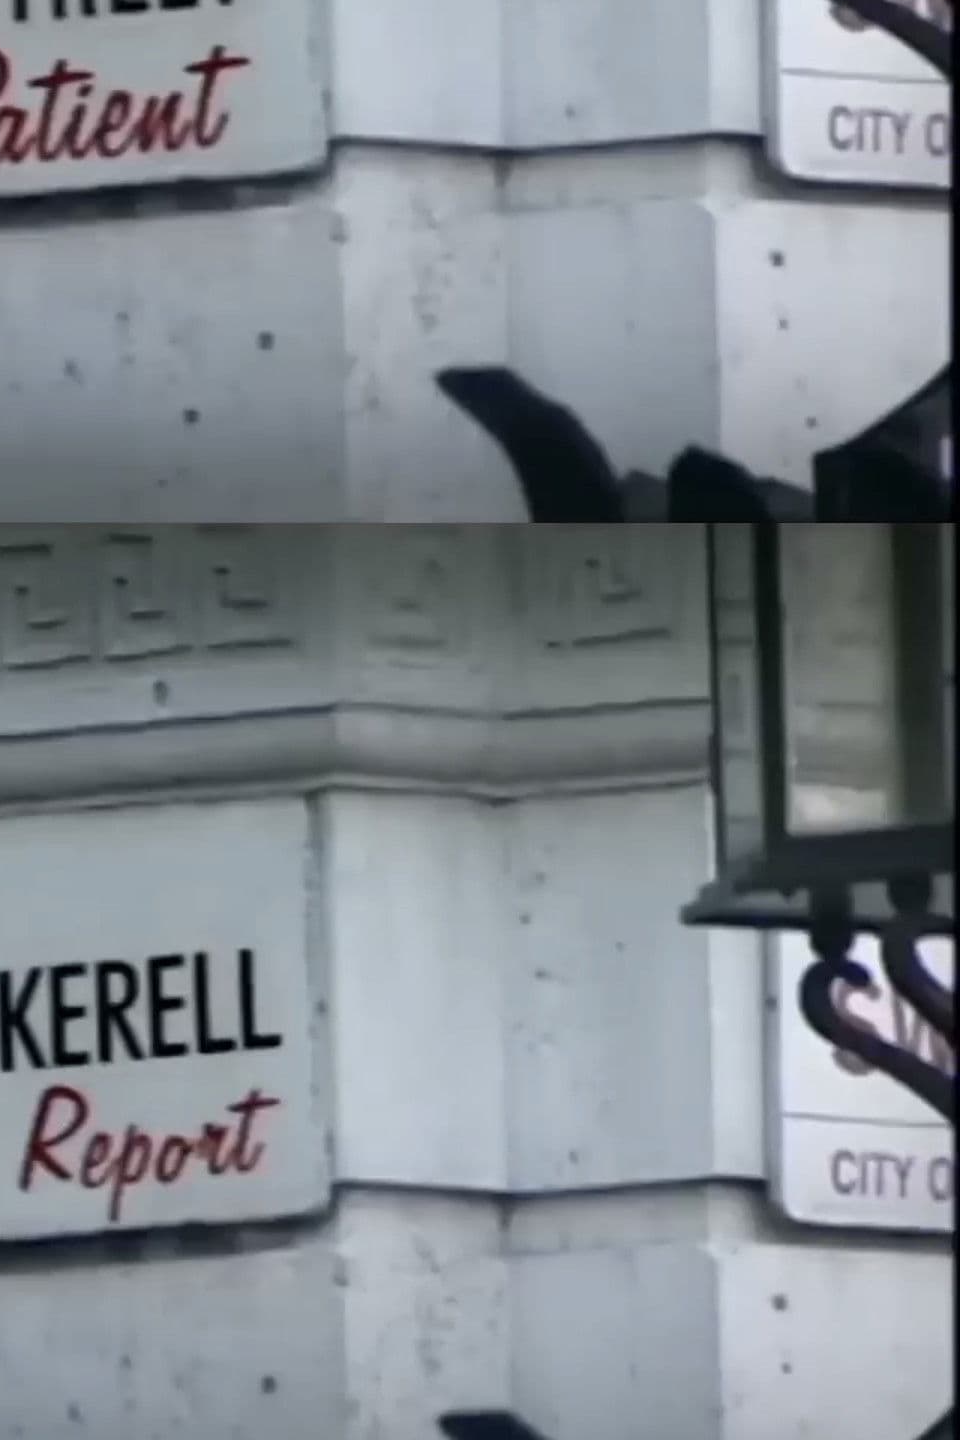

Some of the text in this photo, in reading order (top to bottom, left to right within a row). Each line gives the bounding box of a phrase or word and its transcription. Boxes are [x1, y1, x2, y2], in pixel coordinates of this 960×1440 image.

[828, 105, 912, 154] CITY
[17, 1086, 281, 1221] Report
[830, 1149, 916, 1199] CITY
